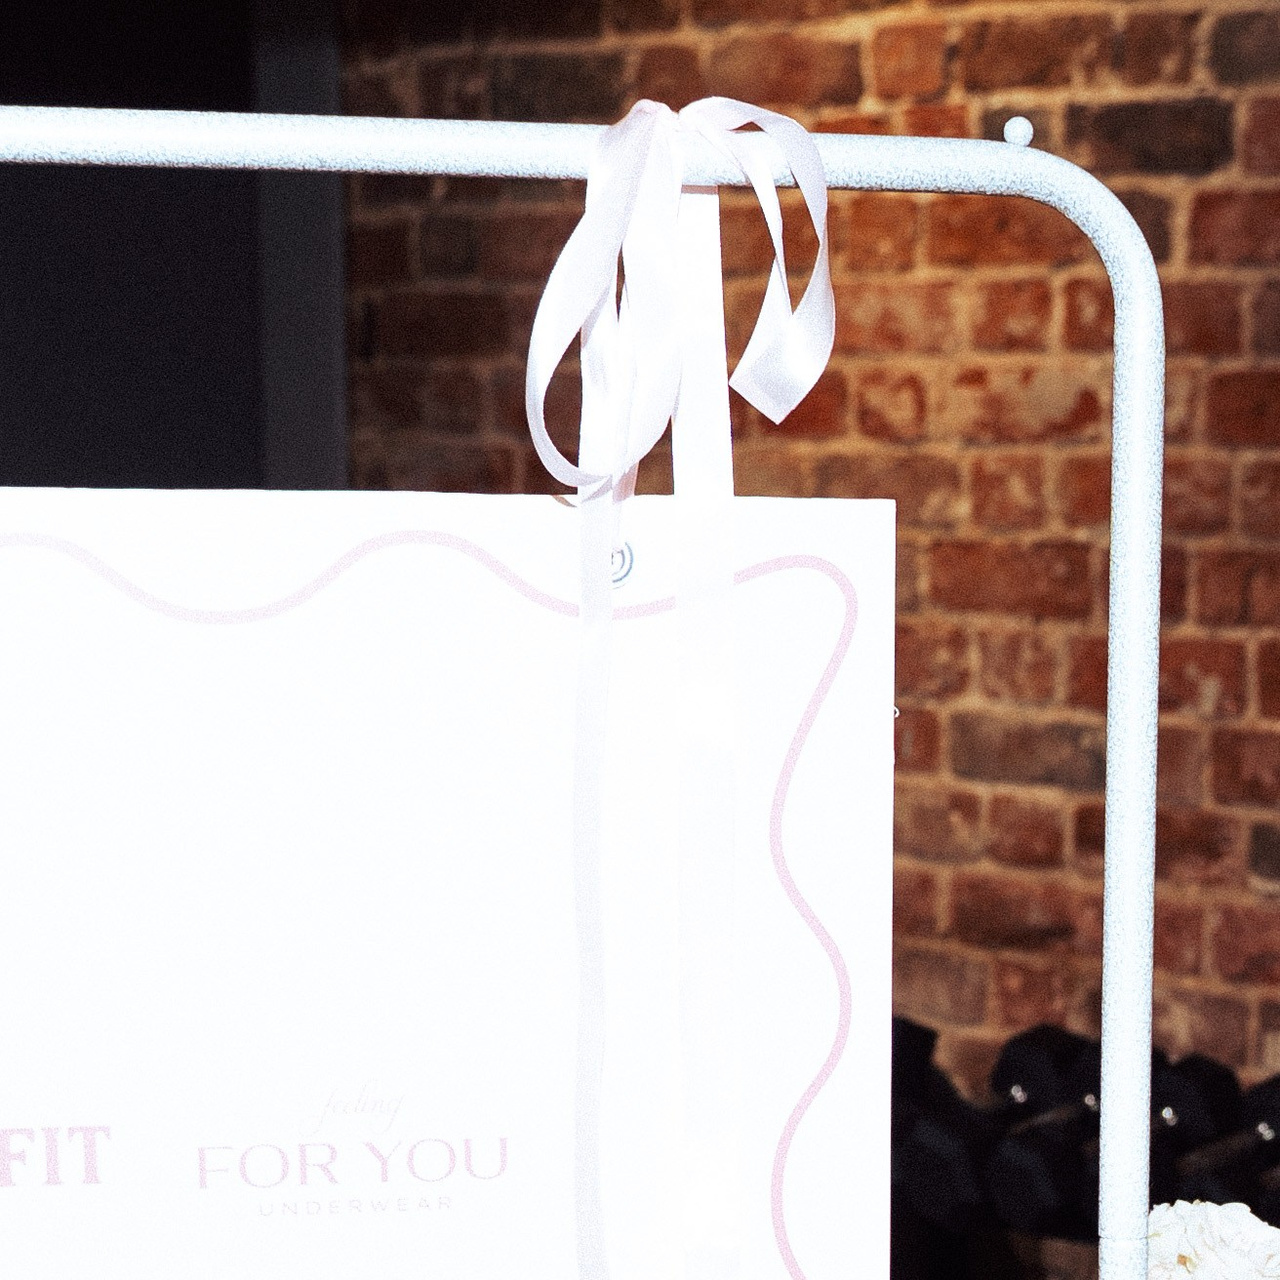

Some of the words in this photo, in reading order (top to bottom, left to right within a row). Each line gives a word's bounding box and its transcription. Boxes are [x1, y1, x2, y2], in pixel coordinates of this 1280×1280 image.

[0, 1125, 111, 1188] FIT
[197, 1143, 339, 1190] FOR
[364, 1136, 509, 1183] YOU
[258, 1196, 453, 1218] UNDERWEAR
